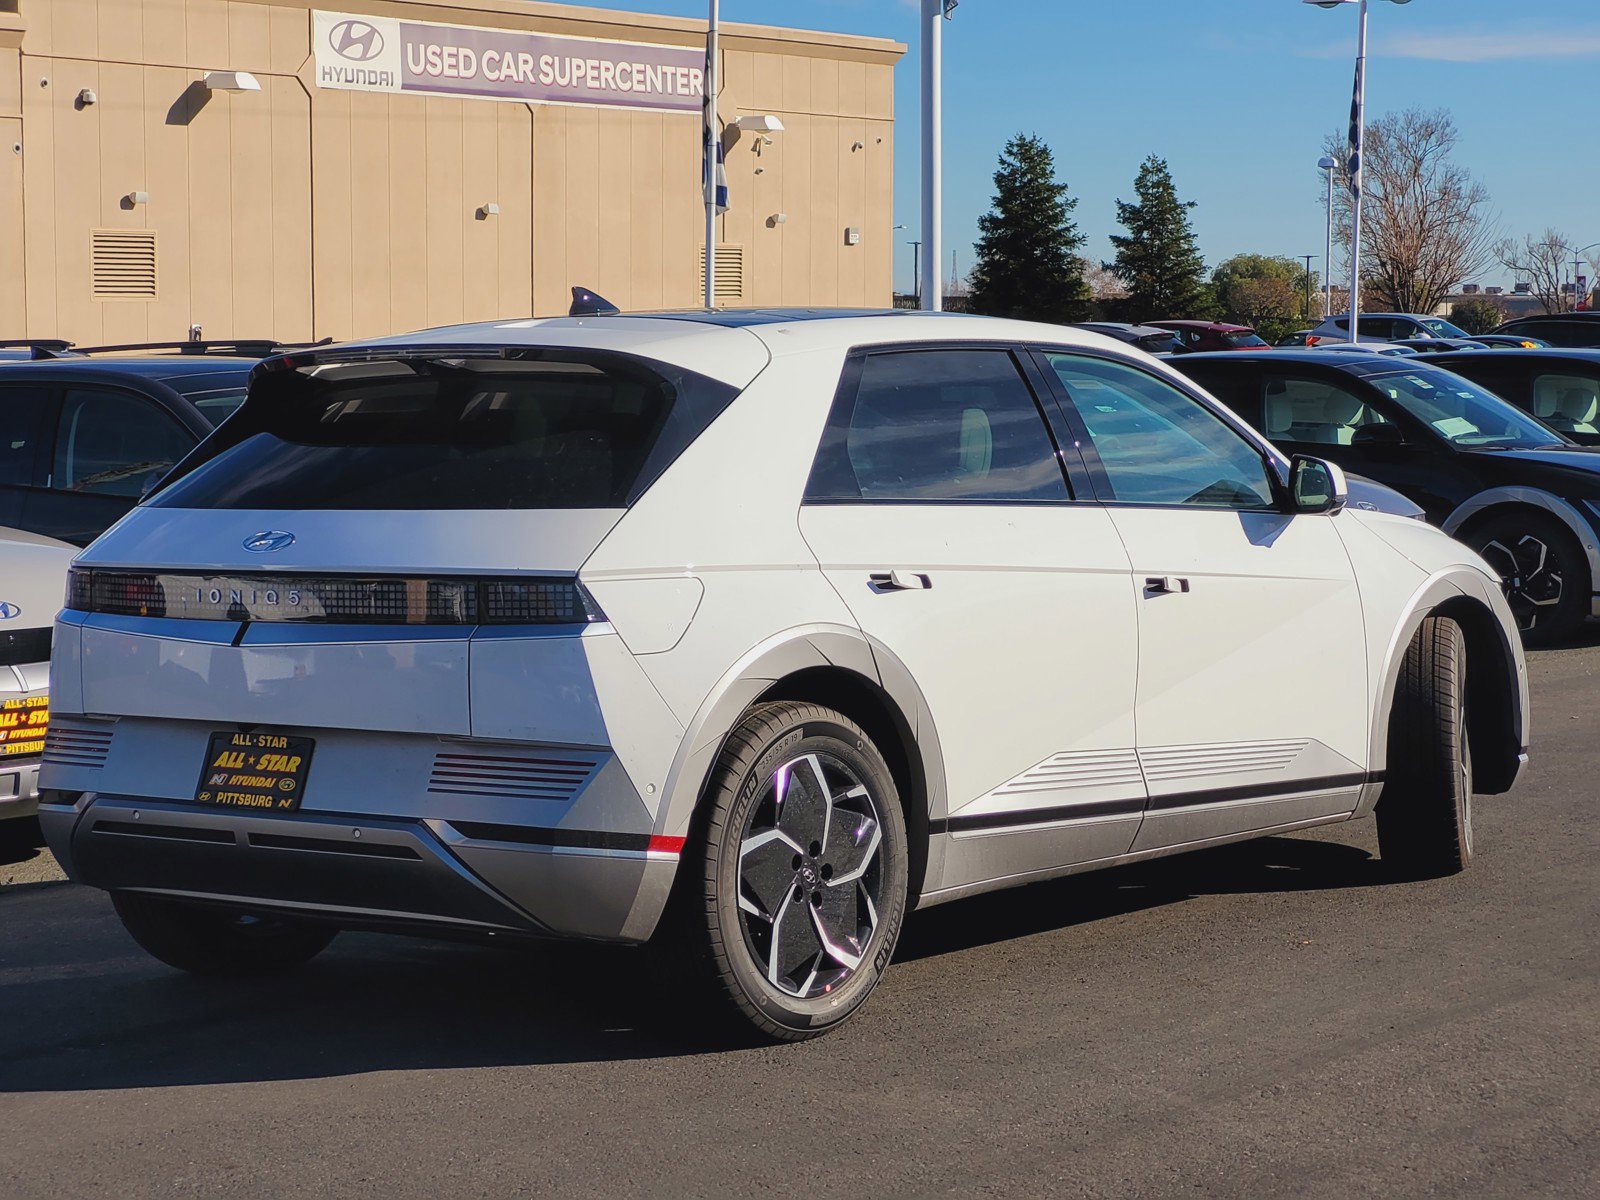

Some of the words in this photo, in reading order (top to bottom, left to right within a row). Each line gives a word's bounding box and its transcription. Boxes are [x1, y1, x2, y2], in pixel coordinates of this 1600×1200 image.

[321, 65, 395, 87] HYUNDAI
[406, 42, 478, 79] USED
[481, 49, 536, 83] CAR
[538, 55, 704, 97] SUPERCENTER
[196, 588, 279, 605] IONIQ
[288, 590, 300, 605] 5
[4, 699, 23, 709] ALL
[9, 727, 47, 739] HYUNDAI
[231, 733, 252, 746] ALL
[258, 735, 288, 748] STAR
[213, 751, 246, 768] ALL
[255, 753, 302, 773] STAR
[228, 775, 277, 788] HYUNDAI
[216, 791, 273, 808] PITTSBURG
[727, 776, 758, 864] MICHELIN
